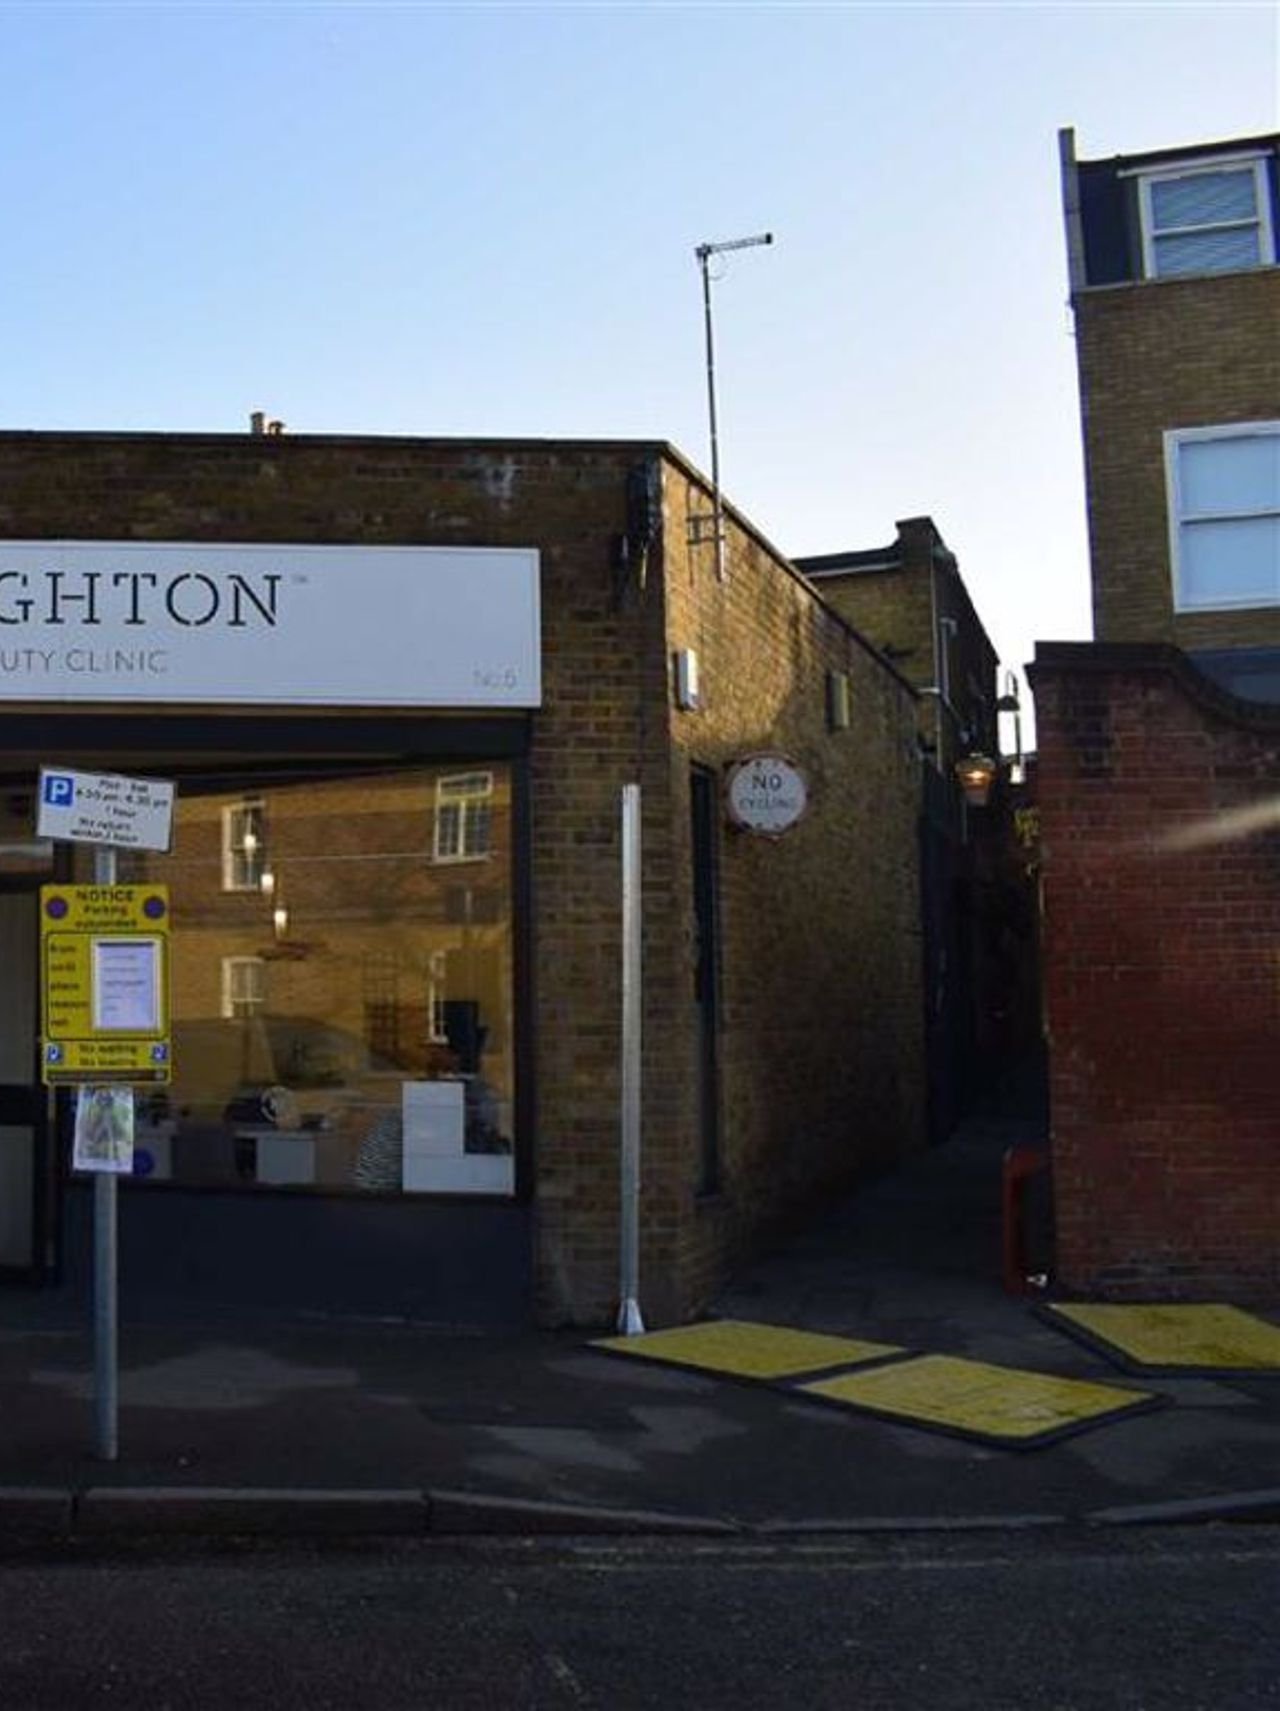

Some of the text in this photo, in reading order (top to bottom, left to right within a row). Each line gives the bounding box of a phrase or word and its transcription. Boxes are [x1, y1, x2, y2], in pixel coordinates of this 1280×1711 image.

[66, 650, 168, 674] CLINIC
[752, 773, 782, 792] NO
[76, 889, 135, 902] NOTICE
[83, 904, 129, 917] Parking
